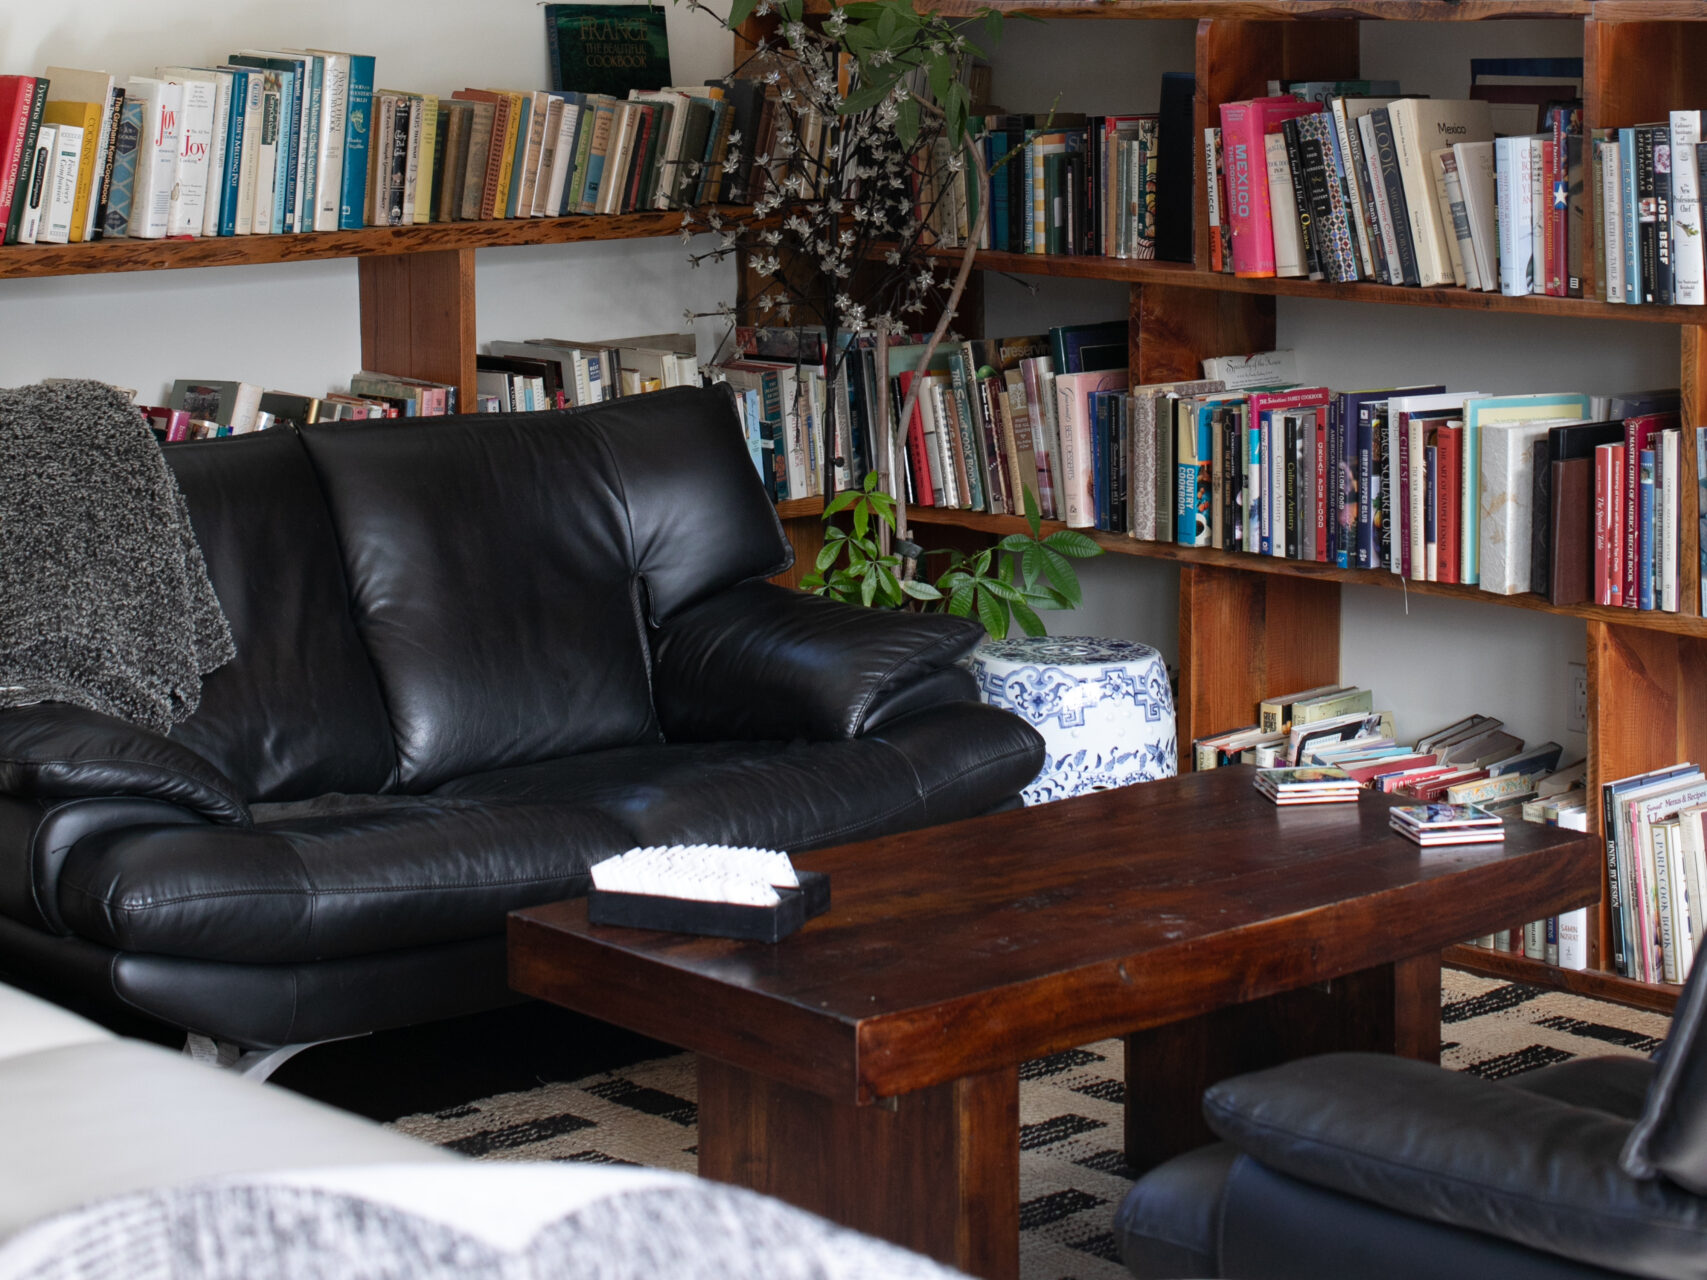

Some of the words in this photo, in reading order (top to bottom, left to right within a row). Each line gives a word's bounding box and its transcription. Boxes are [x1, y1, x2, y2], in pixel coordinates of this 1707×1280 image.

[580, 16, 649, 40] FRANCE
[586, 55, 647, 67] COOKBOOK
[24, 83, 33, 104] STEP
[33, 84, 47, 120] Tycoons
[313, 88, 321, 101] The
[21, 105, 30, 115] BY
[310, 102, 318, 131] Master
[19, 116, 28, 137] STEP
[28, 132, 37, 146] the
[32, 121, 39, 130] in
[109, 112, 121, 145] Graham
[155, 104, 175, 147] joy
[1437, 122, 1467, 135] Mexico
[13, 138, 24, 163] PASTA
[83, 117, 96, 167] COOKING
[107, 145, 115, 163] Kerr
[180, 129, 208, 163] joy
[1347, 128, 1359, 161] nobu's
[1374, 121, 1395, 177] LOOK
[4, 163, 19, 207] COOKBOOK
[101, 163, 113, 205] Cookbook
[305, 159, 315, 200] Cookbook
[1229, 165, 1237, 215] COOKBOOK
[1236, 144, 1249, 218] MEXICO
[1370, 154, 1384, 198] Vietnamese
[1647, 178, 1653, 191] TO
[288, 181, 296, 210] RECIPES
[1607, 181, 1615, 203] FROM
[1368, 202, 1378, 222] banh
[1379, 199, 1388, 222] Home
[1657, 196, 1667, 222] JOE
[1300, 214, 1311, 250] Oaxaca
[1389, 186, 1403, 233] MICHELLE
[1396, 233, 1410, 267] OBAMA
[1608, 211, 1616, 237] EARTH
[1625, 204, 1633, 268] GEORGES
[1382, 224, 1395, 255] Cooking
[1659, 231, 1668, 265] BEEF
[953, 369, 962, 387] THE
[959, 431, 971, 457] COOK
[1381, 428, 1390, 463] BACK
[1440, 448, 1448, 463] THE
[964, 459, 976, 483] BOOK
[1065, 445, 1074, 481] DESSERTS
[1440, 465, 1448, 479] ART
[1186, 468, 1195, 509] COUNTRY
[1287, 462, 1295, 497] Culinary
[1381, 465, 1390, 515] SQUARE
[1441, 481, 1448, 491] OF
[1629, 489, 1635, 498] OF
[1275, 493, 1283, 523] Artistry
[1596, 510, 1604, 532] Spanish
[1382, 517, 1390, 546] ONE
[1665, 798, 1681, 807] Menus
[1607, 840, 1616, 868] DINING
[1657, 841, 1666, 875] PARIS
[1609, 869, 1617, 879] BY
[1609, 881, 1619, 908] DESIGN
[1658, 879, 1668, 912] COOK
[1560, 924, 1578, 933] SAMIN
[1661, 916, 1670, 949] BOOK
